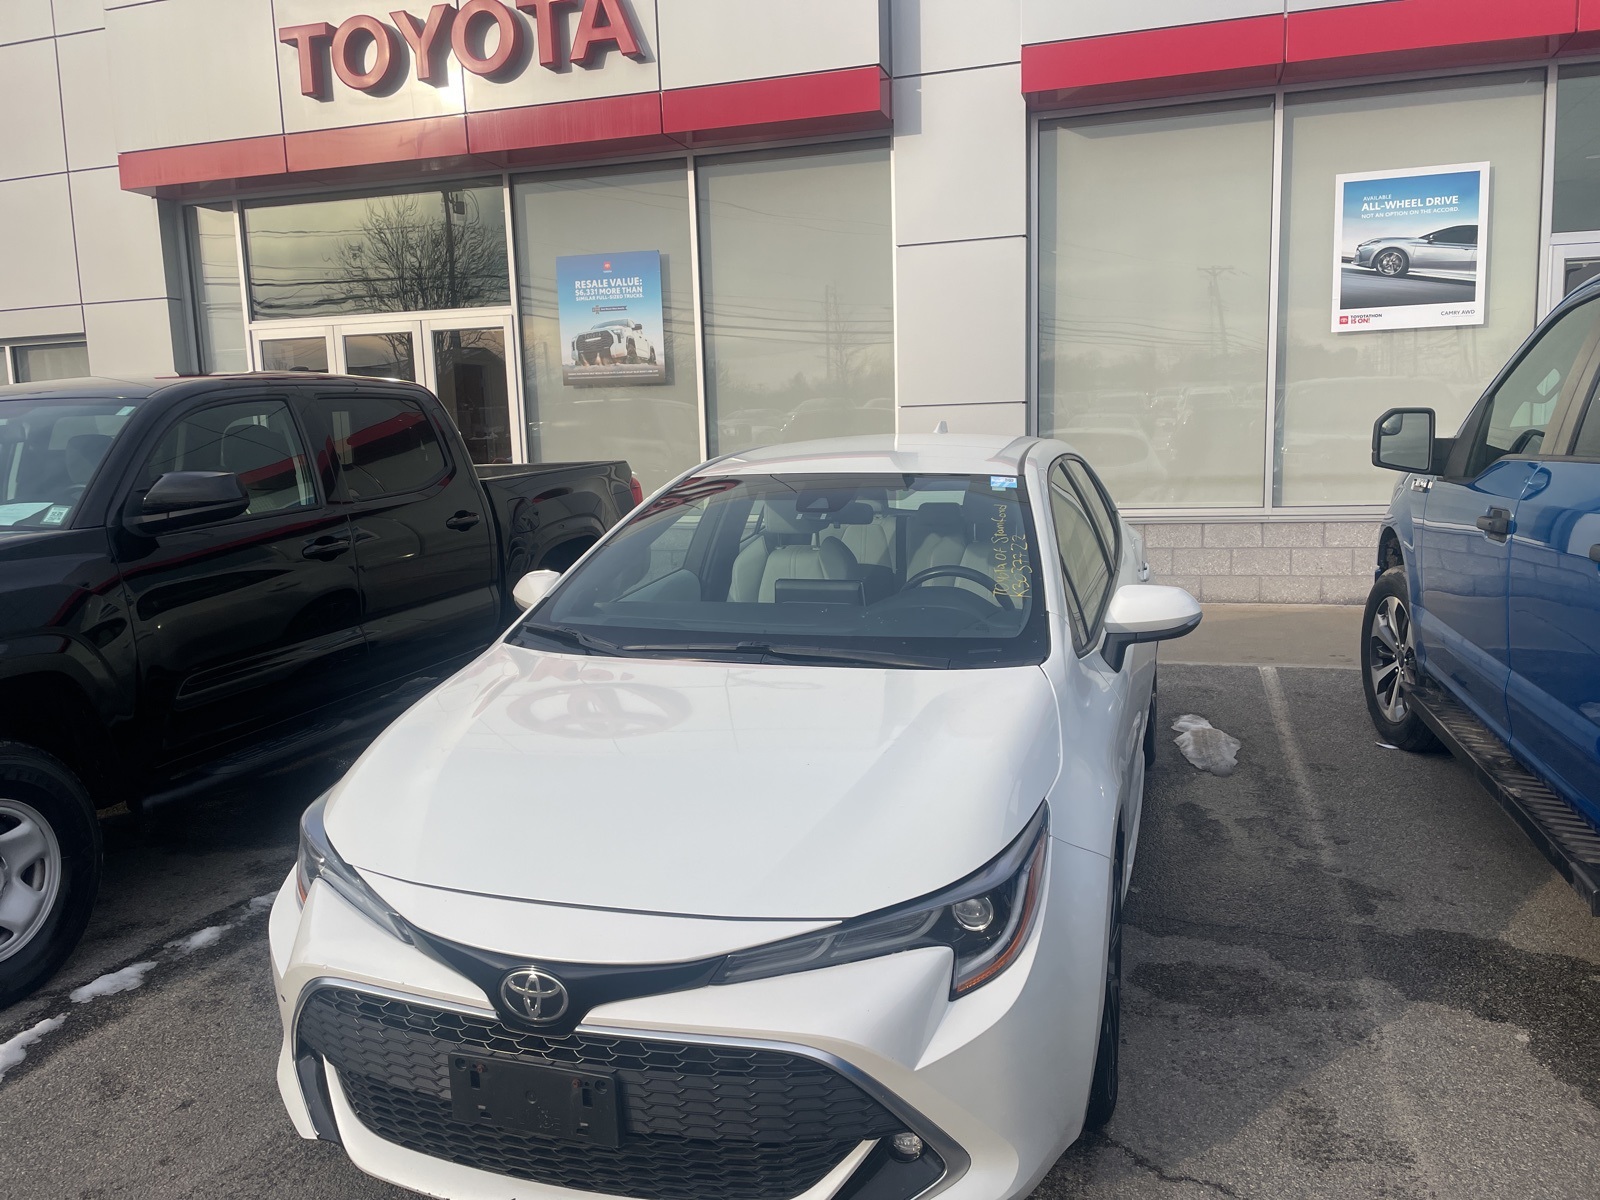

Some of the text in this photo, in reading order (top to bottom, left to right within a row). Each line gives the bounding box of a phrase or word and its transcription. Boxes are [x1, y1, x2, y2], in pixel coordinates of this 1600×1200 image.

[279, 0, 644, 97] TOYOTA
[1361, 195, 1459, 211] ALL-WHEEL DRIVE
[575, 277, 643, 289] RESALE VALUE:
[575, 286, 643, 297] $6,331 MORE THAN
